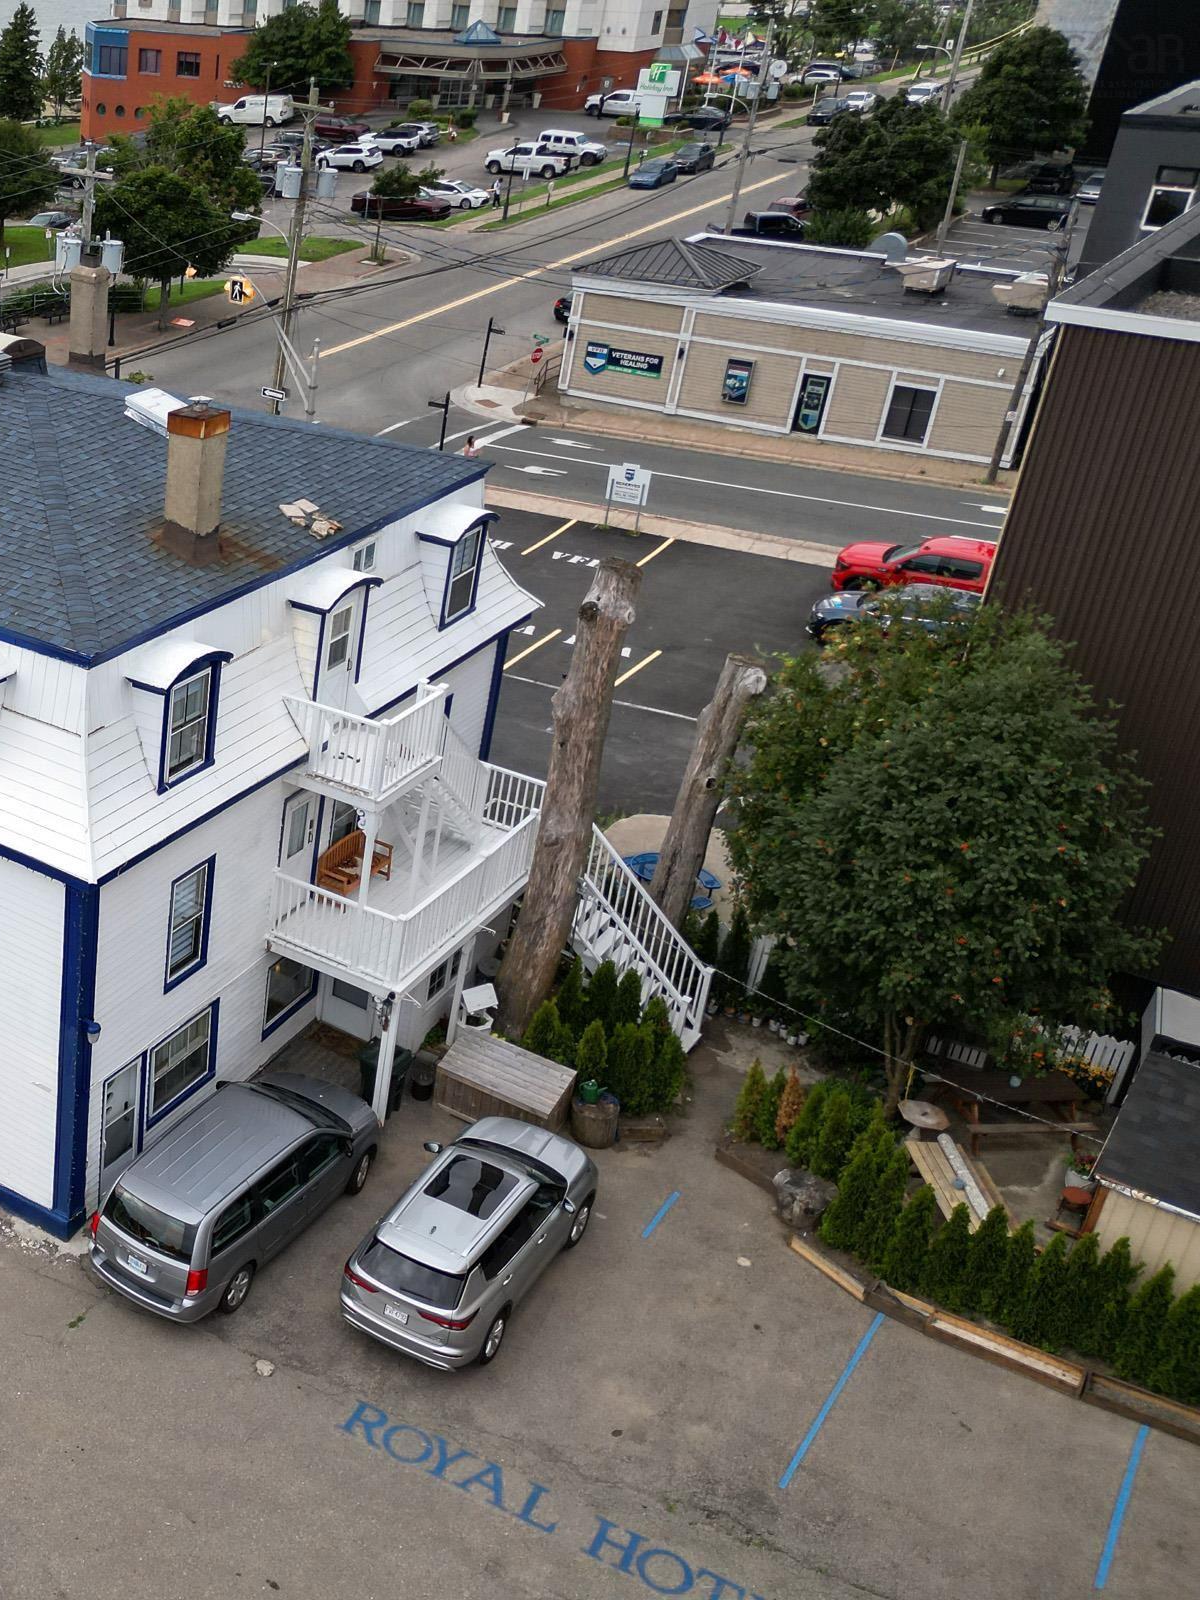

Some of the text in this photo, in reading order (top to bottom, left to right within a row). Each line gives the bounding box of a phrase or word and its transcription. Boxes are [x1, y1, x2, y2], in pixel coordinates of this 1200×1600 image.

[611, 351, 660, 365] VETERANS FOR
[619, 359, 649, 370] HEALING
[335, 1400, 766, 1600] ROYAL HOT
